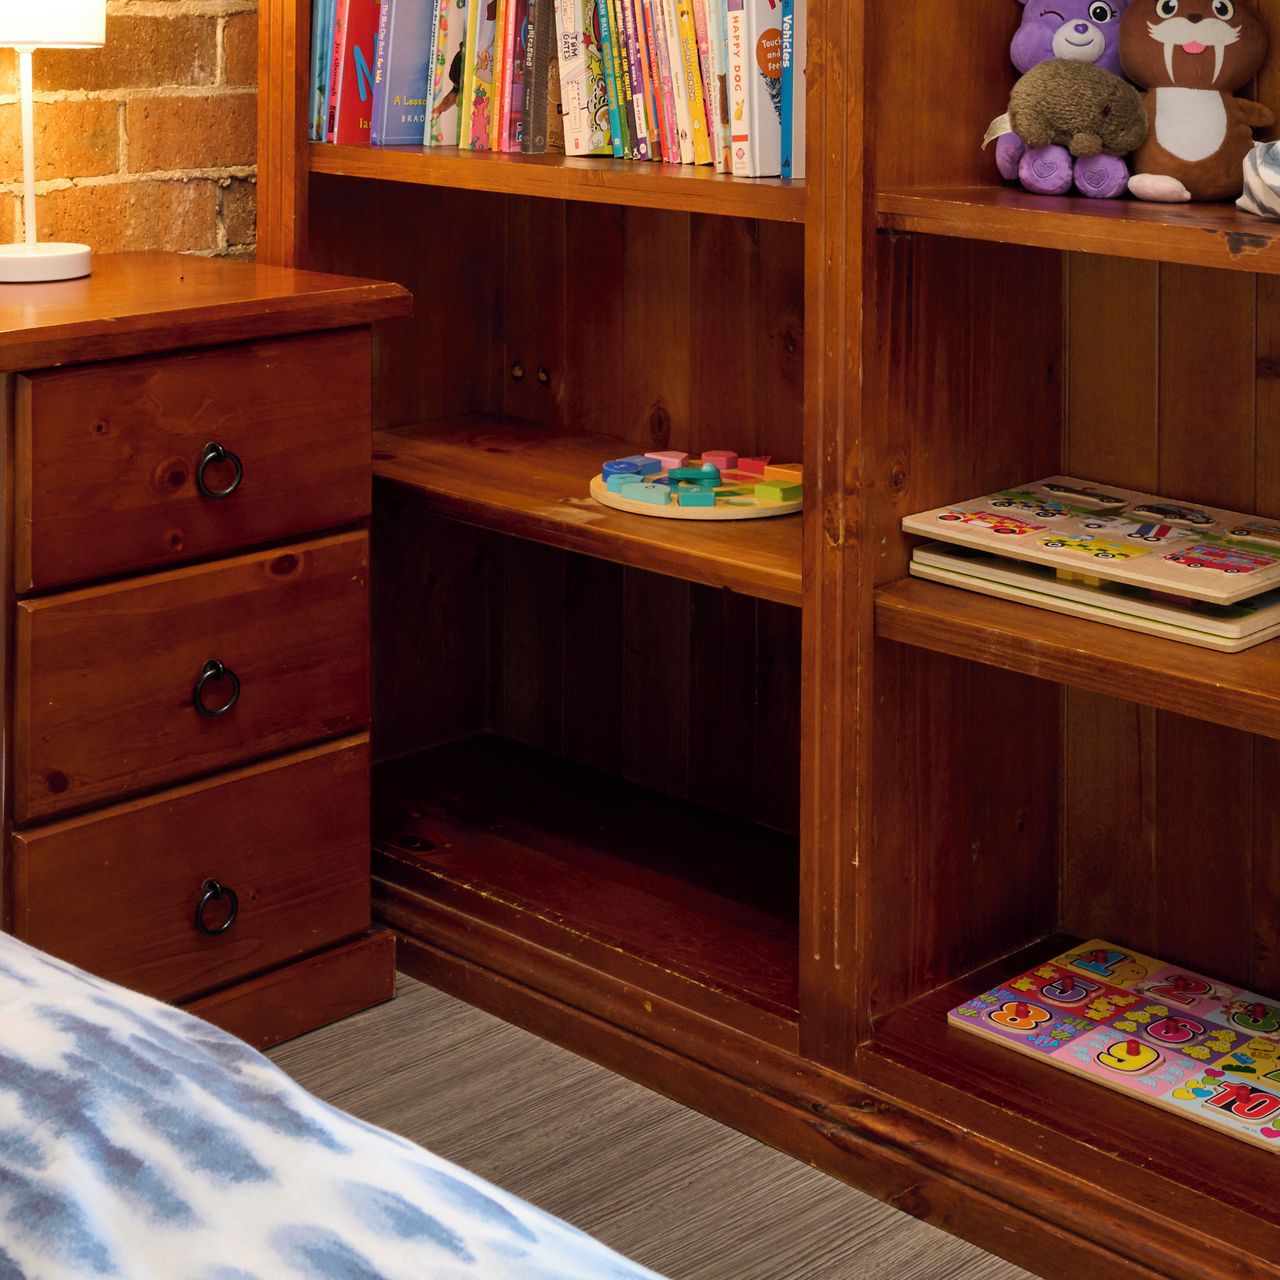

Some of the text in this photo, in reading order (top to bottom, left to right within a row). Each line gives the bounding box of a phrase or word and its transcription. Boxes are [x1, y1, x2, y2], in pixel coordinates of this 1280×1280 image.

[600, 17, 608, 36] BALL
[732, 15, 740, 58] HAPPY
[782, 15, 793, 68] Vehicles
[563, 34, 571, 59] GATES
[570, 34, 578, 57] TOM
[647, 27, 656, 62] CRACKING
[767, 49, 781, 59] and
[331, 55, 339, 97] Alborough
[624, 72, 632, 101] CHALLENGE
[687, 69, 696, 101] SHOWDOWN
[693, 71, 702, 106] SCHOOL
[733, 65, 742, 91] DOG
[393, 96, 401, 105] A
[1145, 974, 1213, 1005] 2
[1041, 976, 1101, 1002] 5
[1146, 1016, 1206, 1043] 6
[989, 1001, 1053, 1031] 8
[1097, 1039, 1160, 1072] 9
